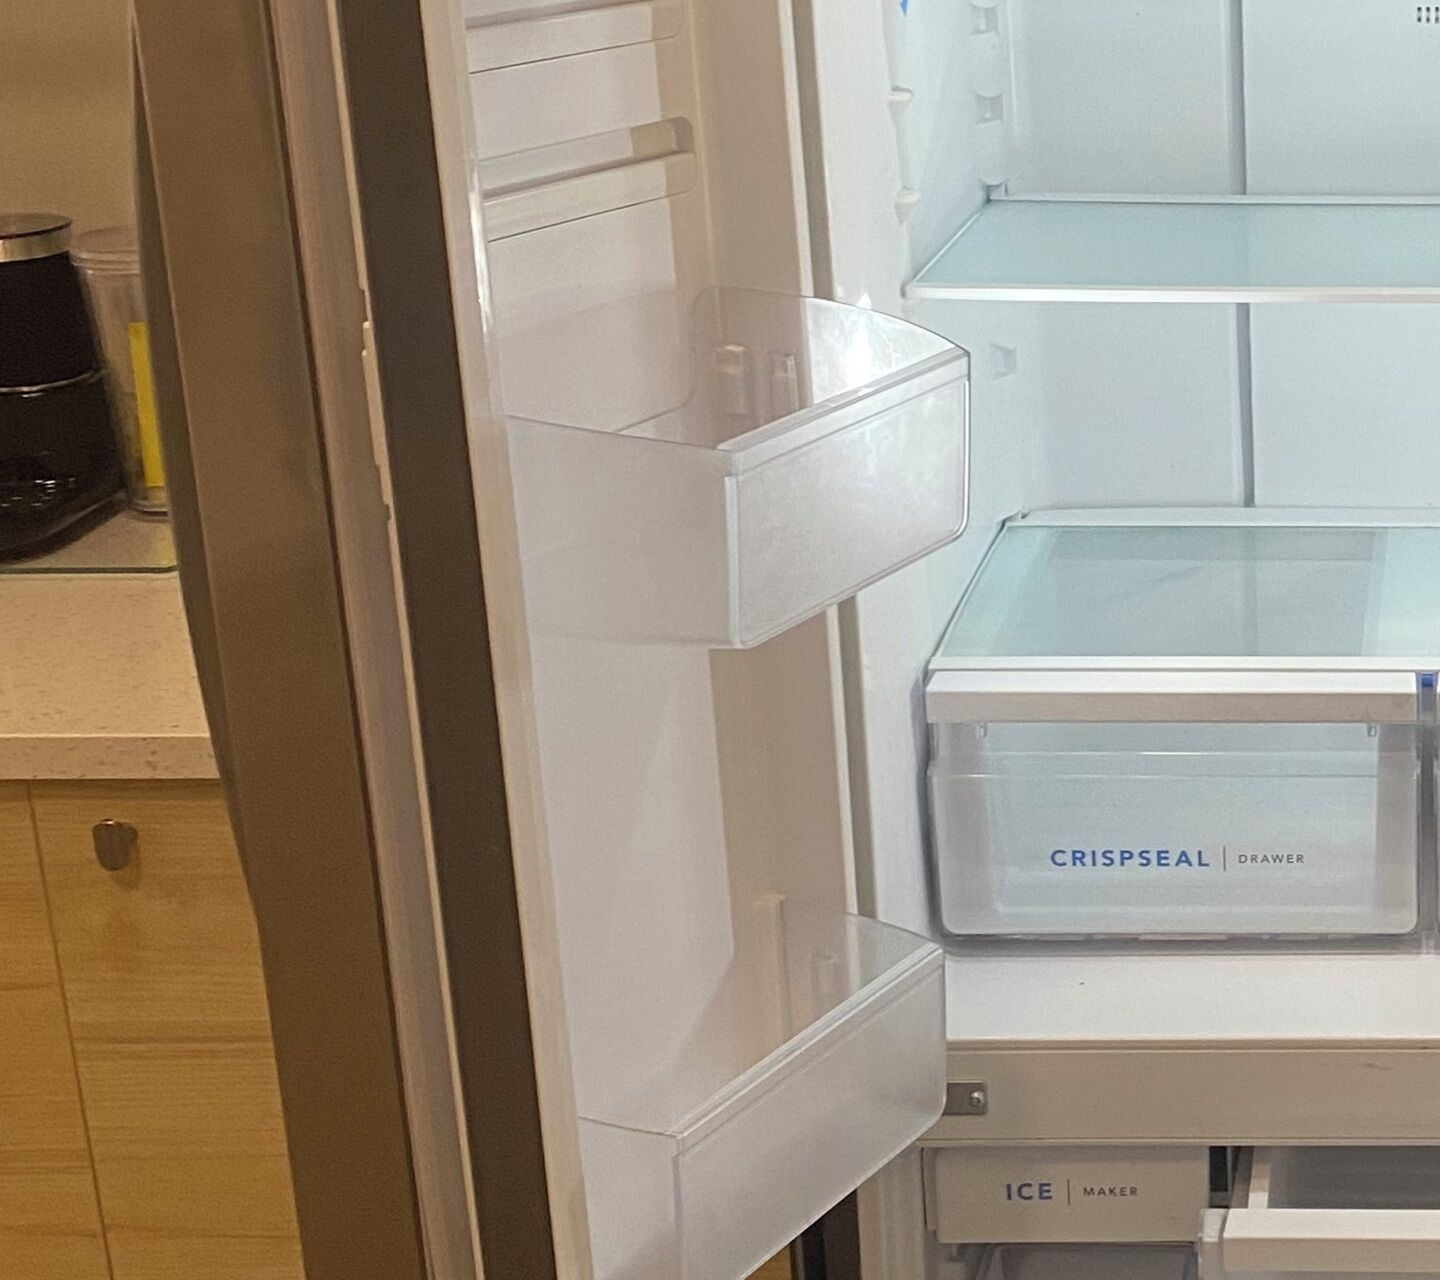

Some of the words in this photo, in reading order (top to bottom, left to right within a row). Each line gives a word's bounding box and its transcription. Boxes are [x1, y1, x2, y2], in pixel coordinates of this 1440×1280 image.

[1050, 849, 1210, 867] CRISPSEAL
[1238, 853, 1305, 865] DRAWER
[1006, 1183, 1053, 1201] ICE
[1083, 1186, 1139, 1198] MAKER
